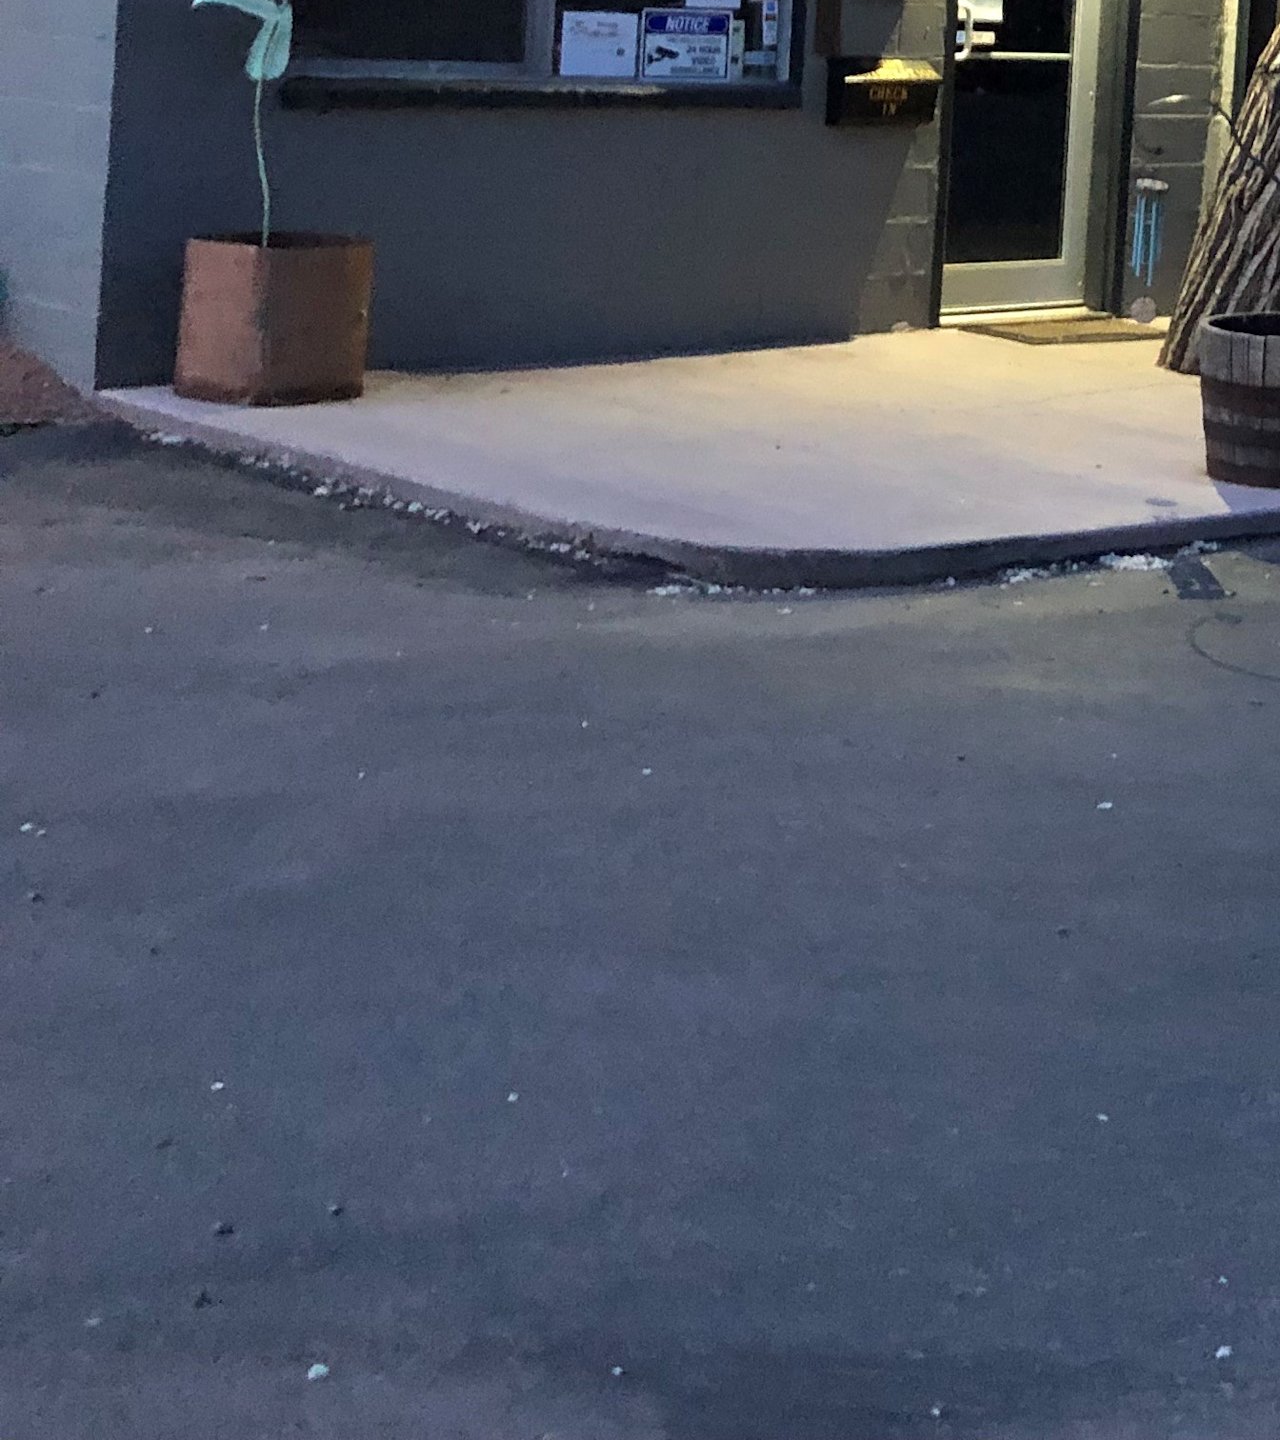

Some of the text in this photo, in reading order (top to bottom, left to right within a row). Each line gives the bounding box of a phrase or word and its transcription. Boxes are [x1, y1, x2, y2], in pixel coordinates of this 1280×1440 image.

[665, 15, 711, 33] NOTICE
[868, 85, 908, 101] CHECK
[882, 102, 897, 116] IN
